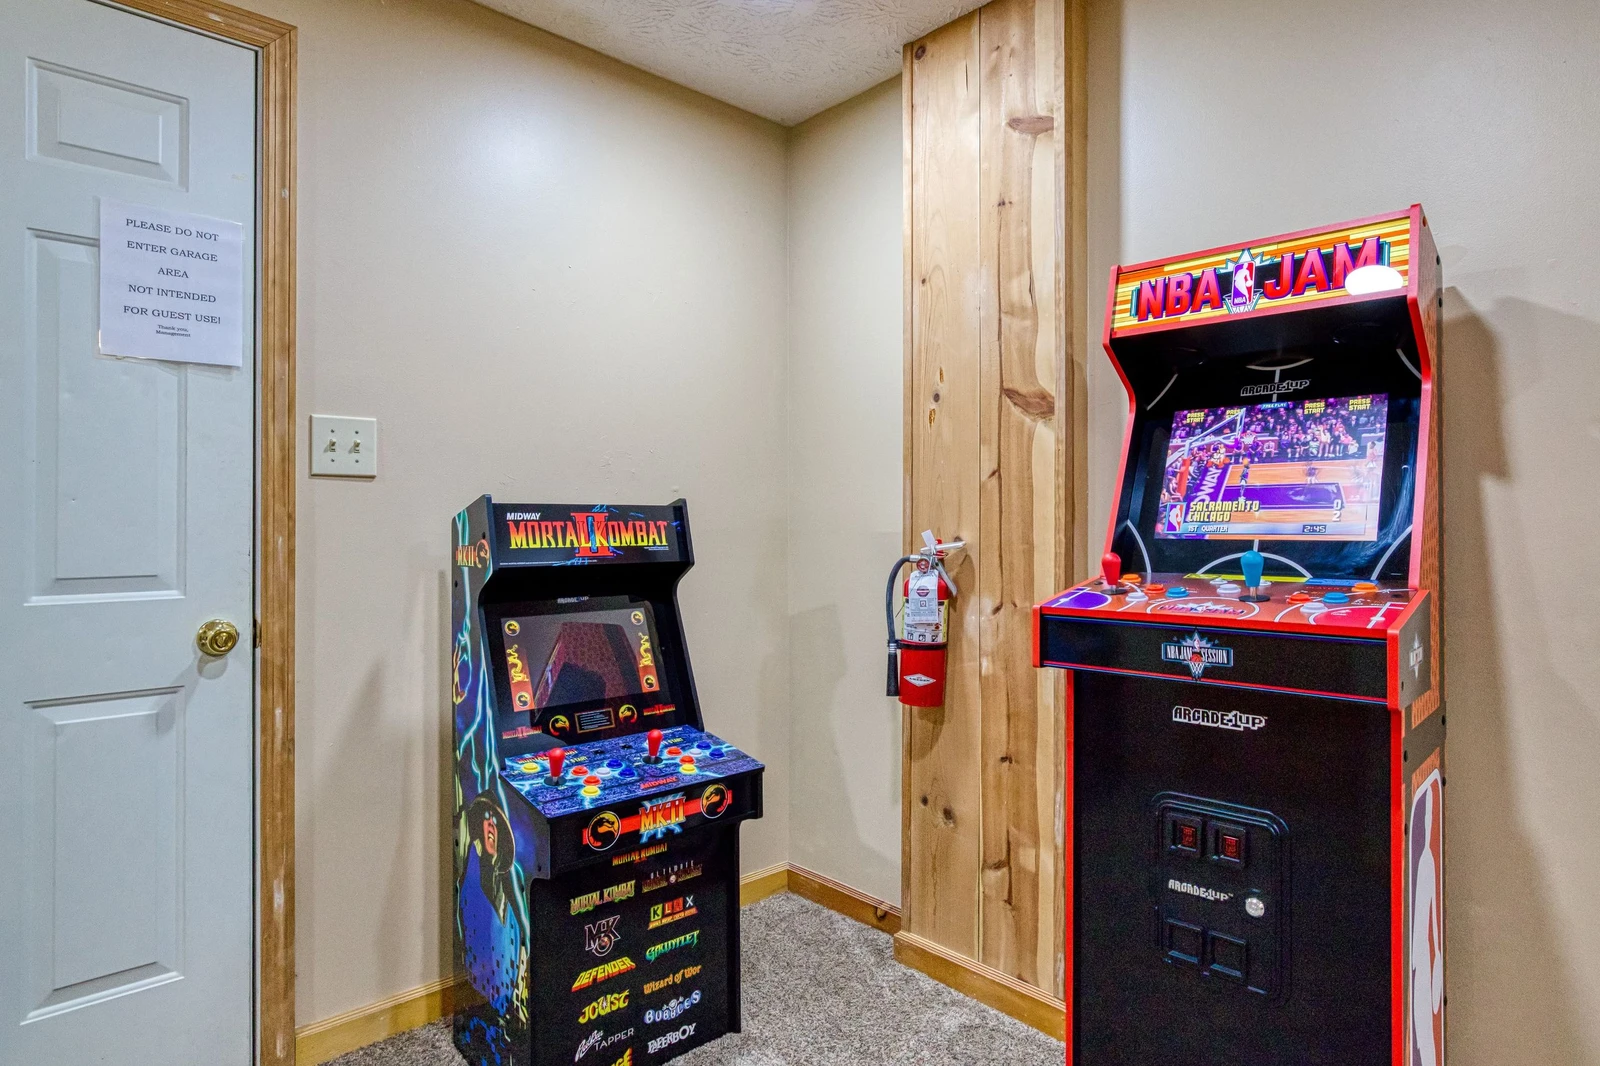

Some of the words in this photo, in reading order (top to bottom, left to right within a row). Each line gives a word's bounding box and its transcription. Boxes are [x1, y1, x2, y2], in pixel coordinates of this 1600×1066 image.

[126, 218, 172, 233] PLEASE
[175, 226, 192, 237] DO
[195, 230, 219, 241] NOT
[126, 240, 167, 254] ENTER
[170, 247, 218, 262] GARAGE
[157, 266, 189, 279] AREA
[1137, 268, 1224, 322] NBA
[1263, 236, 1381, 300] JAM
[128, 284, 153, 296] NOT
[156, 288, 217, 303] INTENDED
[123, 305, 148, 316] FOR
[151, 308, 192, 321] GUEST
[195, 314, 221, 325] USE!
[155, 329, 191, 338] Management
[157, 324, 176, 332] Thank
[1187, 411, 1205, 419] PRESS
[1304, 401, 1326, 409] PRESS
[1304, 407, 1325, 415] START
[1348, 403, 1371, 411] START
[1189, 499, 1260, 512] SACRAMENTO
[506, 512, 542, 521] MIDWAY
[1187, 510, 1232, 523] CHICAGO
[1332, 510, 1342, 522] 2
[507, 520, 591, 549] MORTAL
[594, 520, 669, 548] KOMBAT
[1187, 525, 1199, 533] 1ST
[1200, 525, 1229, 533] QUARTER
[1302, 524, 1327, 533] 2:45
[1166, 644, 1180, 660] NBA
[1200, 647, 1228, 664] SESSION
[640, 776, 678, 790] MIDWAY
[611, 849, 641, 866] MORTAL
[640, 843, 668, 860] KOMBAT
[570, 890, 602, 915] MORTAL
[602, 880, 636, 903] KOMBAT
[645, 929, 700, 963] GAUNTLET
[571, 956, 637, 992] DEFENDER
[643, 973, 674, 994] Wizard
[673, 968, 684, 984] of
[683, 964, 702, 980] Wor
[578, 988, 630, 1024] JOUST
[593, 1027, 634, 1051] TAPPER
[647, 1022, 697, 1054] PAPERBOY
